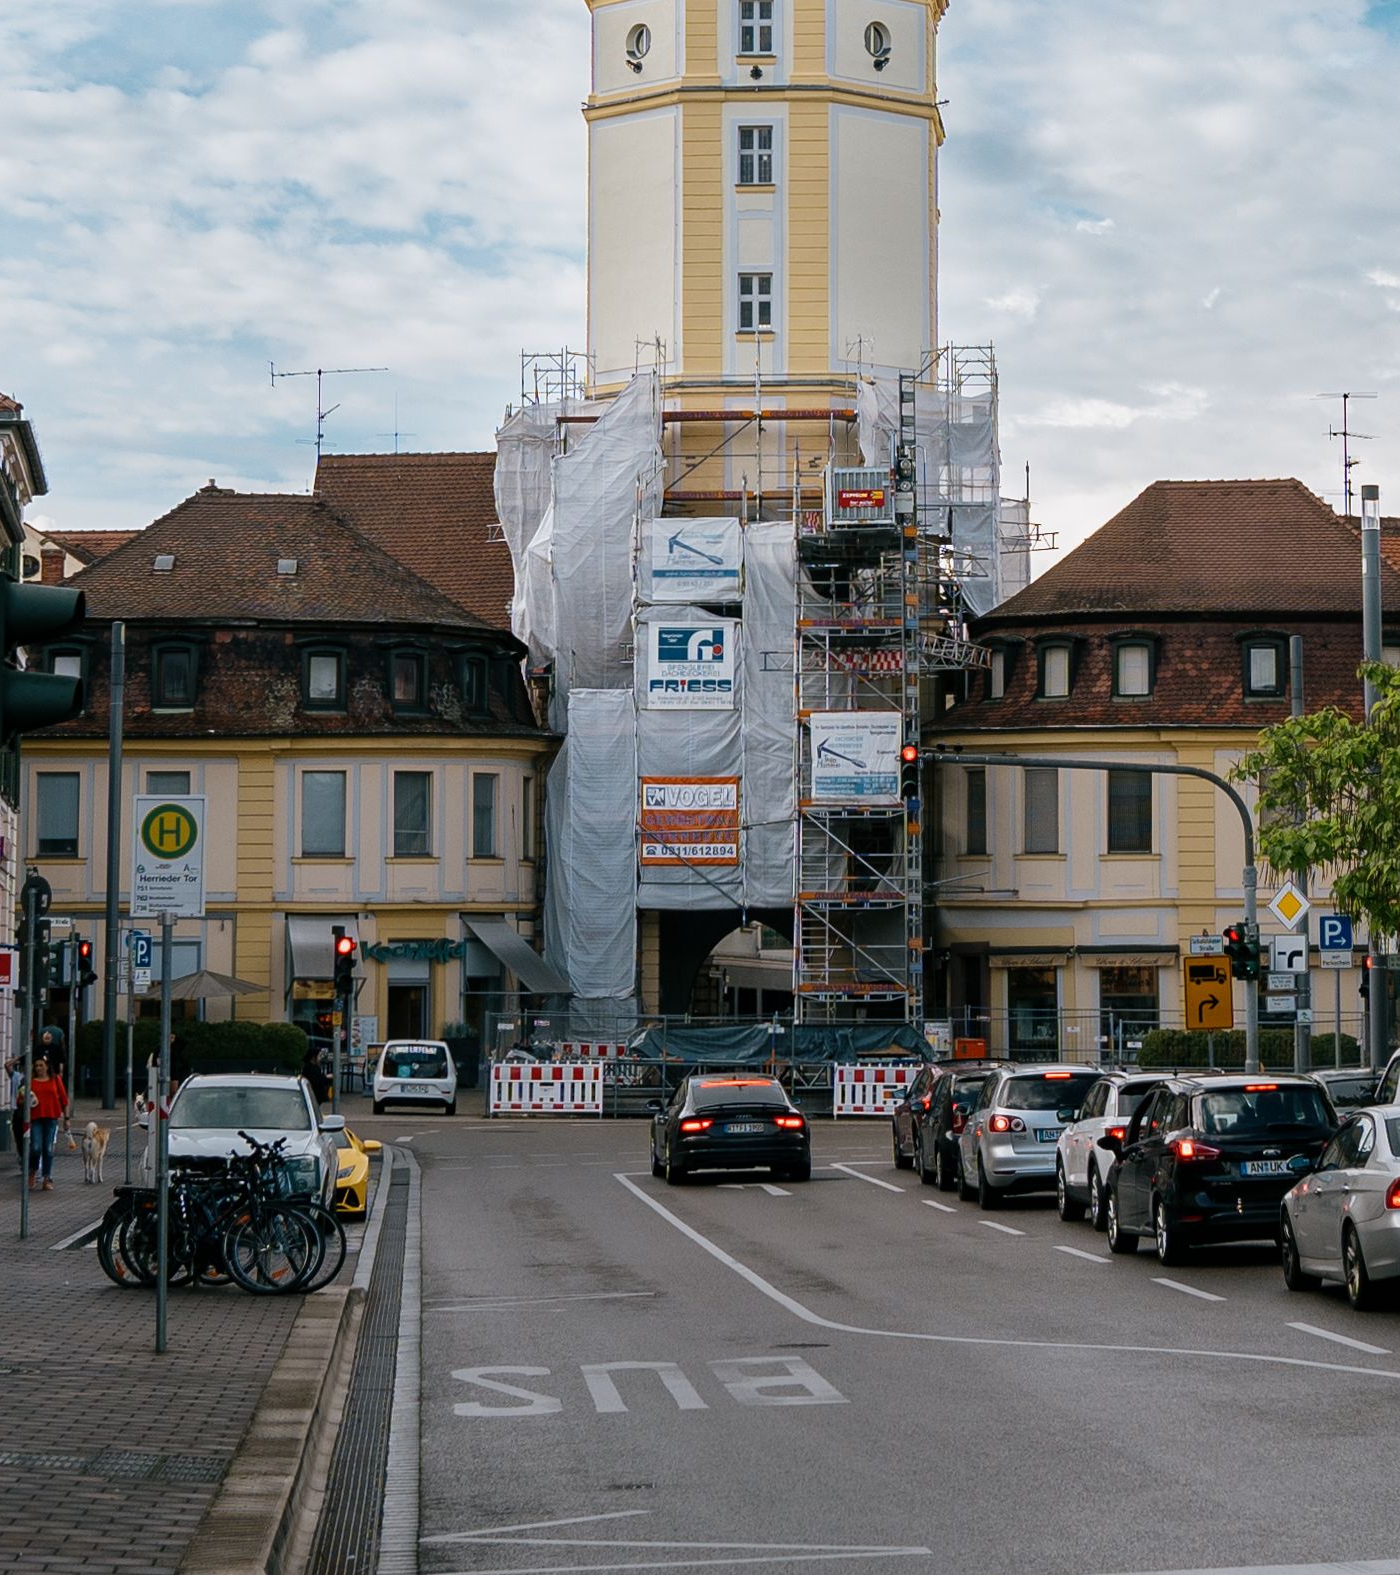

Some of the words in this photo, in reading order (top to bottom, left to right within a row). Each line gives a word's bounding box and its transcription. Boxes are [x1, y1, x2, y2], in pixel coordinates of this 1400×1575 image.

[666, 786, 735, 807] VOGEL
[158, 815, 182, 847] H
[139, 874, 181, 883] Herrieder
[183, 874, 198, 883] Tor
[1324, 920, 1342, 946] P
[137, 940, 147, 964] P
[1250, 1162, 1263, 1172] AN
[450, 1354, 851, 1418] BUS
